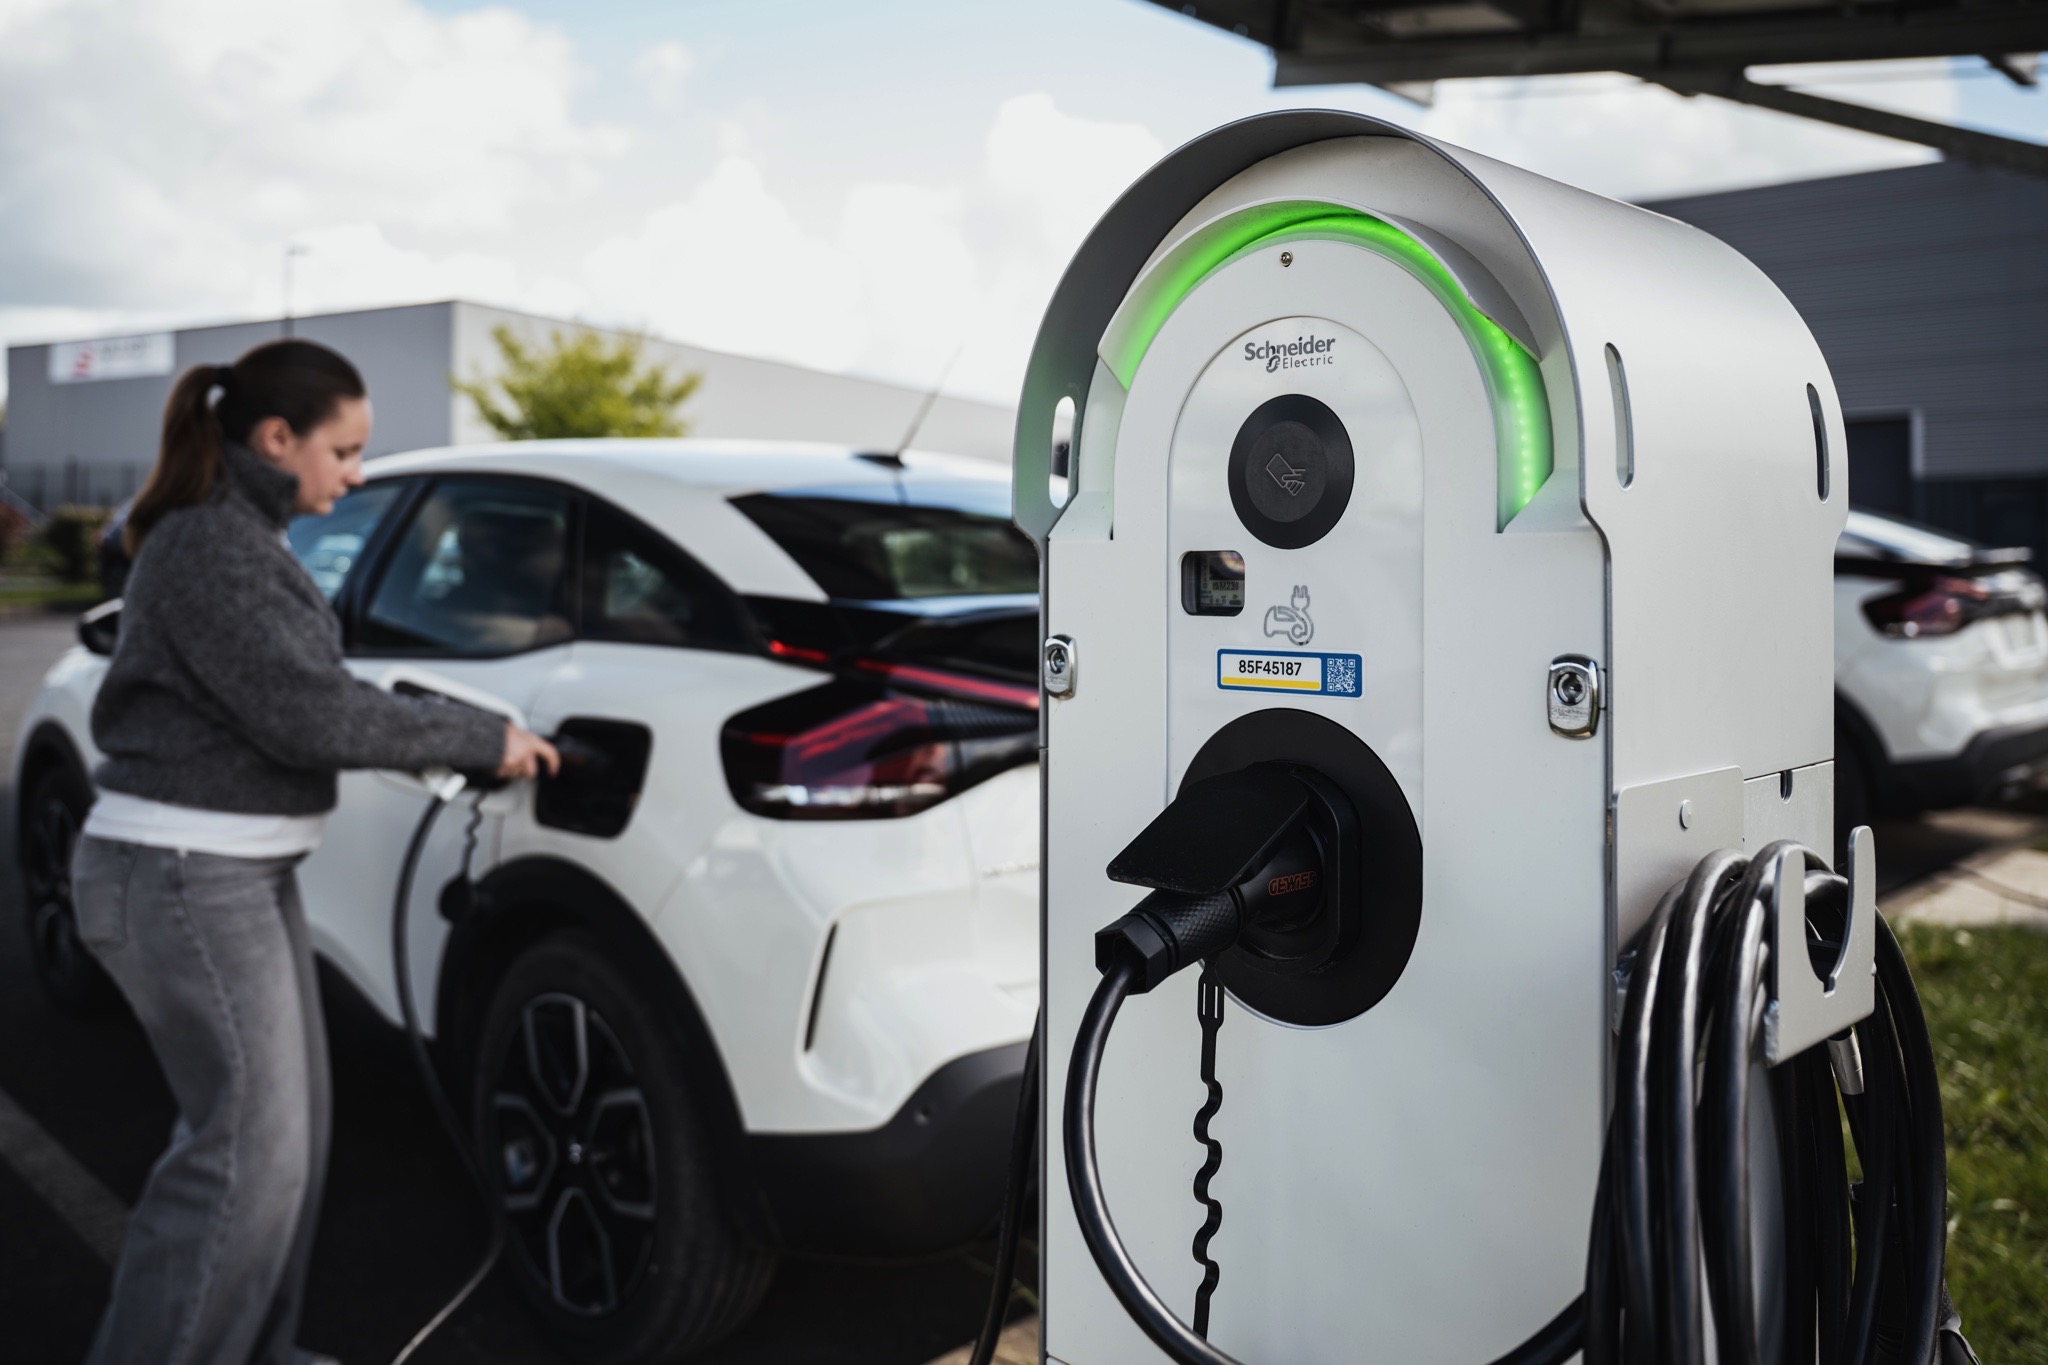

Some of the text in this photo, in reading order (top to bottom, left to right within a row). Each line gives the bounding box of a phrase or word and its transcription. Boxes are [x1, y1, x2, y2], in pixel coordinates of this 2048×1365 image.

[1244, 335, 1336, 361] Schneider
[1282, 354, 1334, 369] Electric
[1238, 660, 1302, 676] 85F45187
